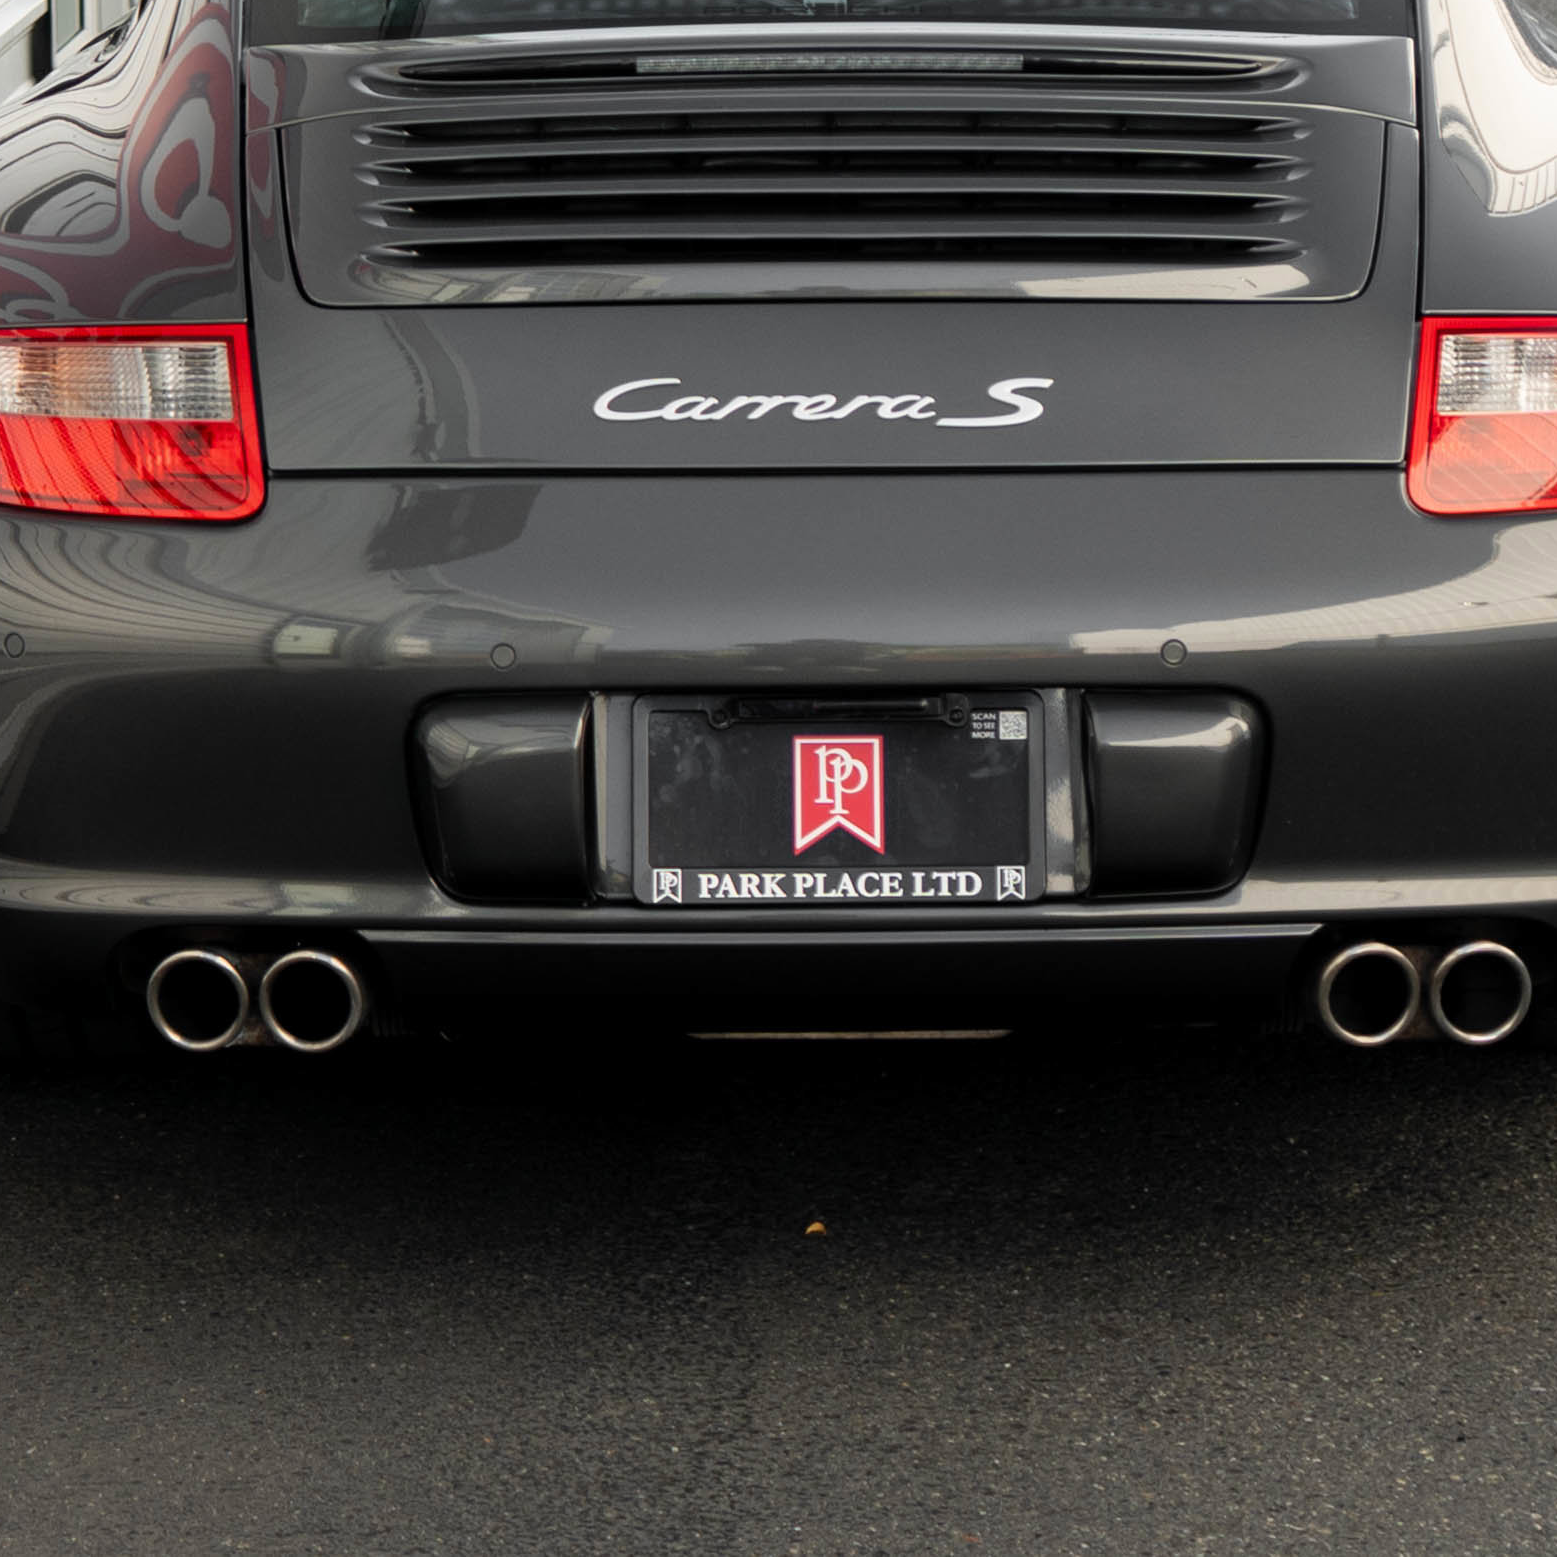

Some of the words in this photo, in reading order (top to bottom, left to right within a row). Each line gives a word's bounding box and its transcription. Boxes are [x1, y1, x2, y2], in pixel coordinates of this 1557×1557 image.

[592, 377, 937, 422] Carrera
[935, 377, 1055, 428] S
[970, 712, 997, 721] SCAN
[972, 721, 983, 730] TO
[970, 731, 996, 739] MORE
[697, 872, 788, 899] PARK
[792, 871, 905, 899] PLACE
[911, 870, 983, 897] LTD
